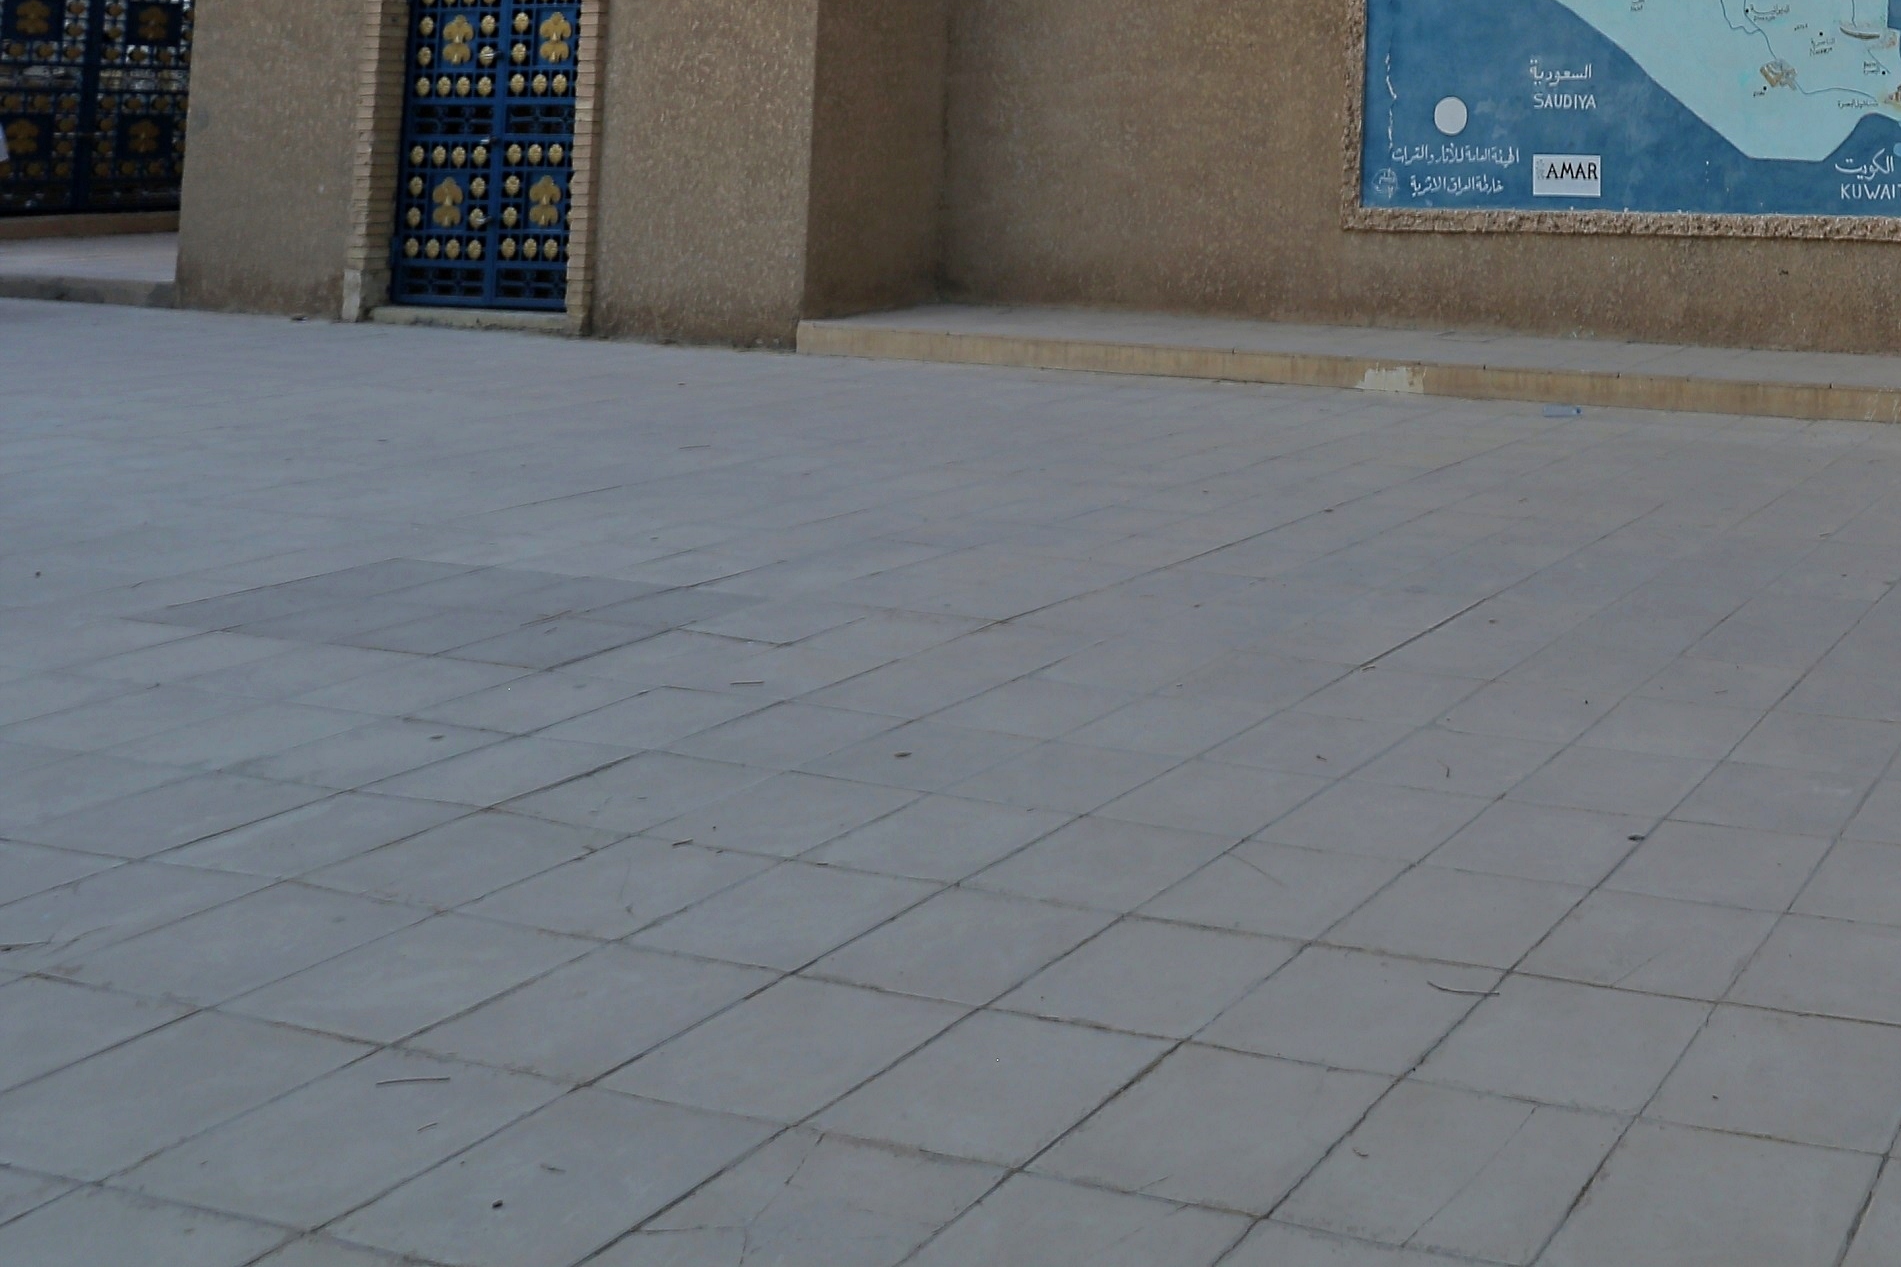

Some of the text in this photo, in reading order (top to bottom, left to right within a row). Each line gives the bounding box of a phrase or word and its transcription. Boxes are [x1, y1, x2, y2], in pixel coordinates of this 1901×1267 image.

[1530, 59, 1592, 86] السعودية
[1533, 93, 1597, 110] SAUDIYA
[1835, 148, 1895, 180] الكويت
